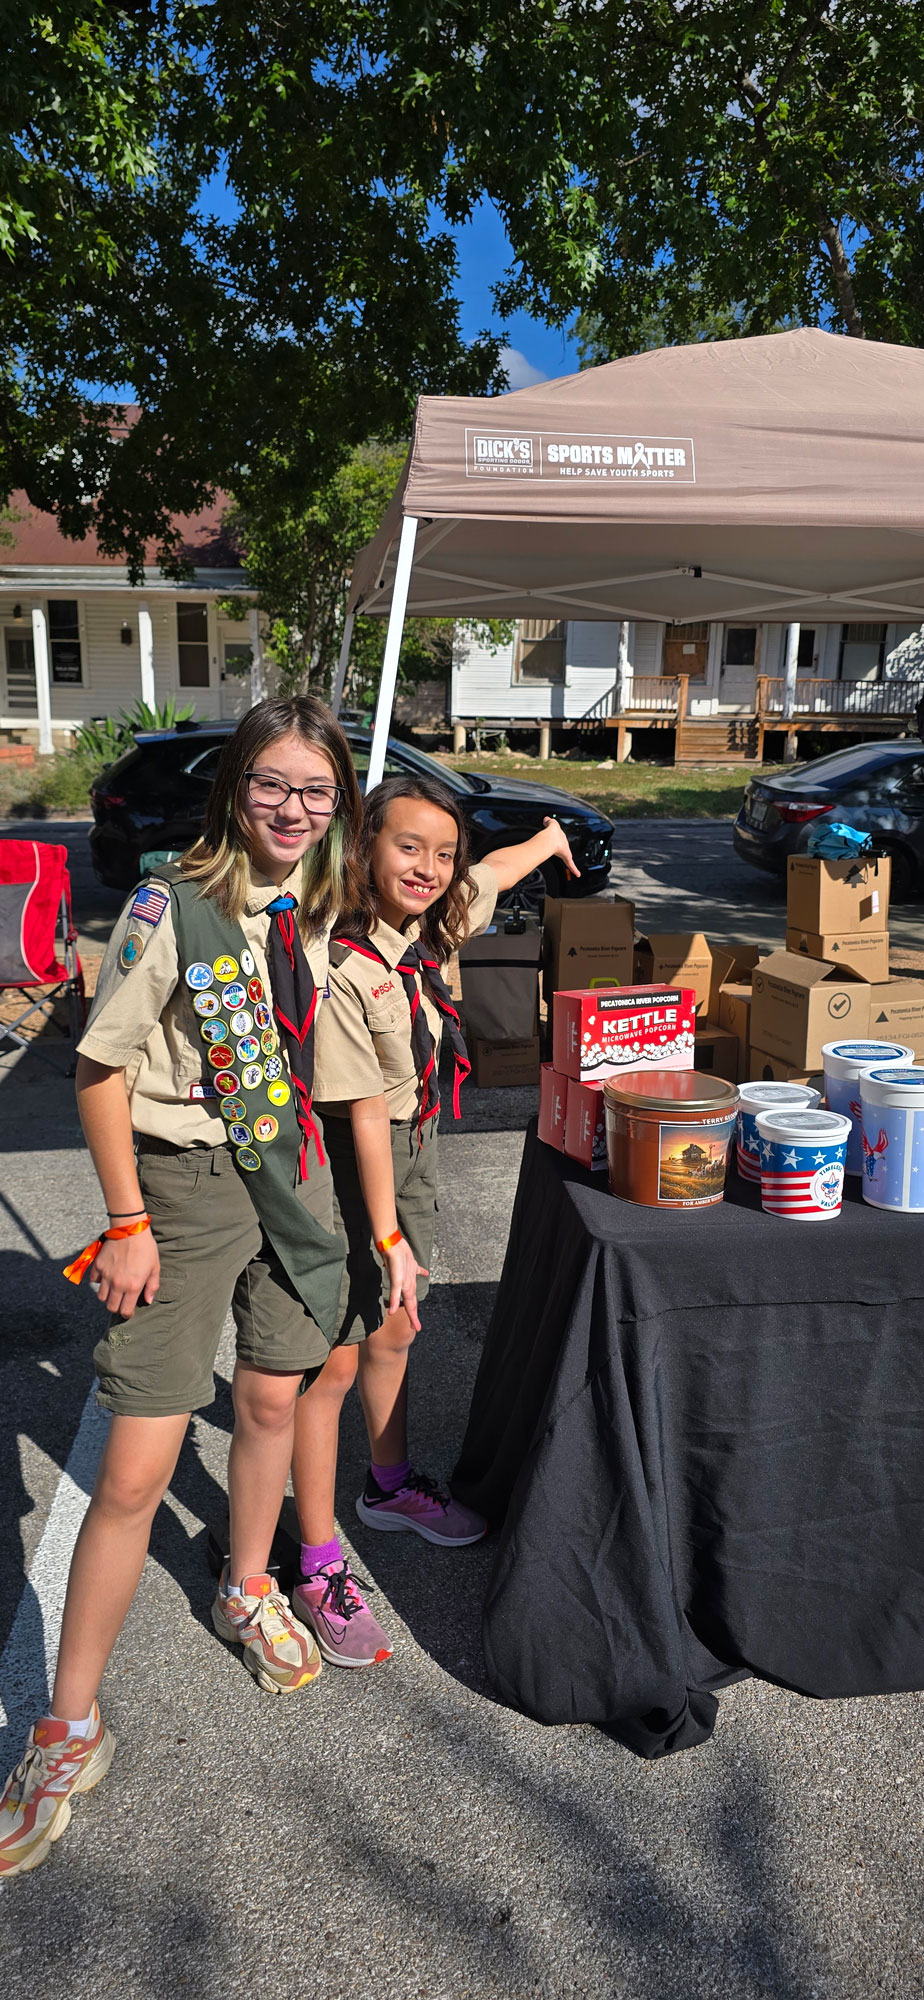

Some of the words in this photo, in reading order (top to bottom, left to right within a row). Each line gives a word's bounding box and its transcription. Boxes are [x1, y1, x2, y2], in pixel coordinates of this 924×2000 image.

[477, 438, 530, 459] DICK'S
[547, 444, 614, 464] SPORTS
[473, 465, 534, 474] FOUNDATION
[560, 467, 583, 476] HELP
[585, 468, 608, 477] SAVE
[610, 469, 639, 477] YOUTH
[640, 469, 675, 478] SPORTS
[379, 981, 395, 995] BSA
[600, 998, 636, 1008] PECATONICA
[635, 997, 652, 1005] RIVER
[652, 995, 679, 1004] POPCORN
[602, 1009, 677, 1034] KETTLE
[601, 1029, 643, 1043] MICROWAVE
[644, 1024, 677, 1035] POPCORN
[701, 1116, 724, 1125] TERRY
[818, 1164, 842, 1176] TIMELESS
